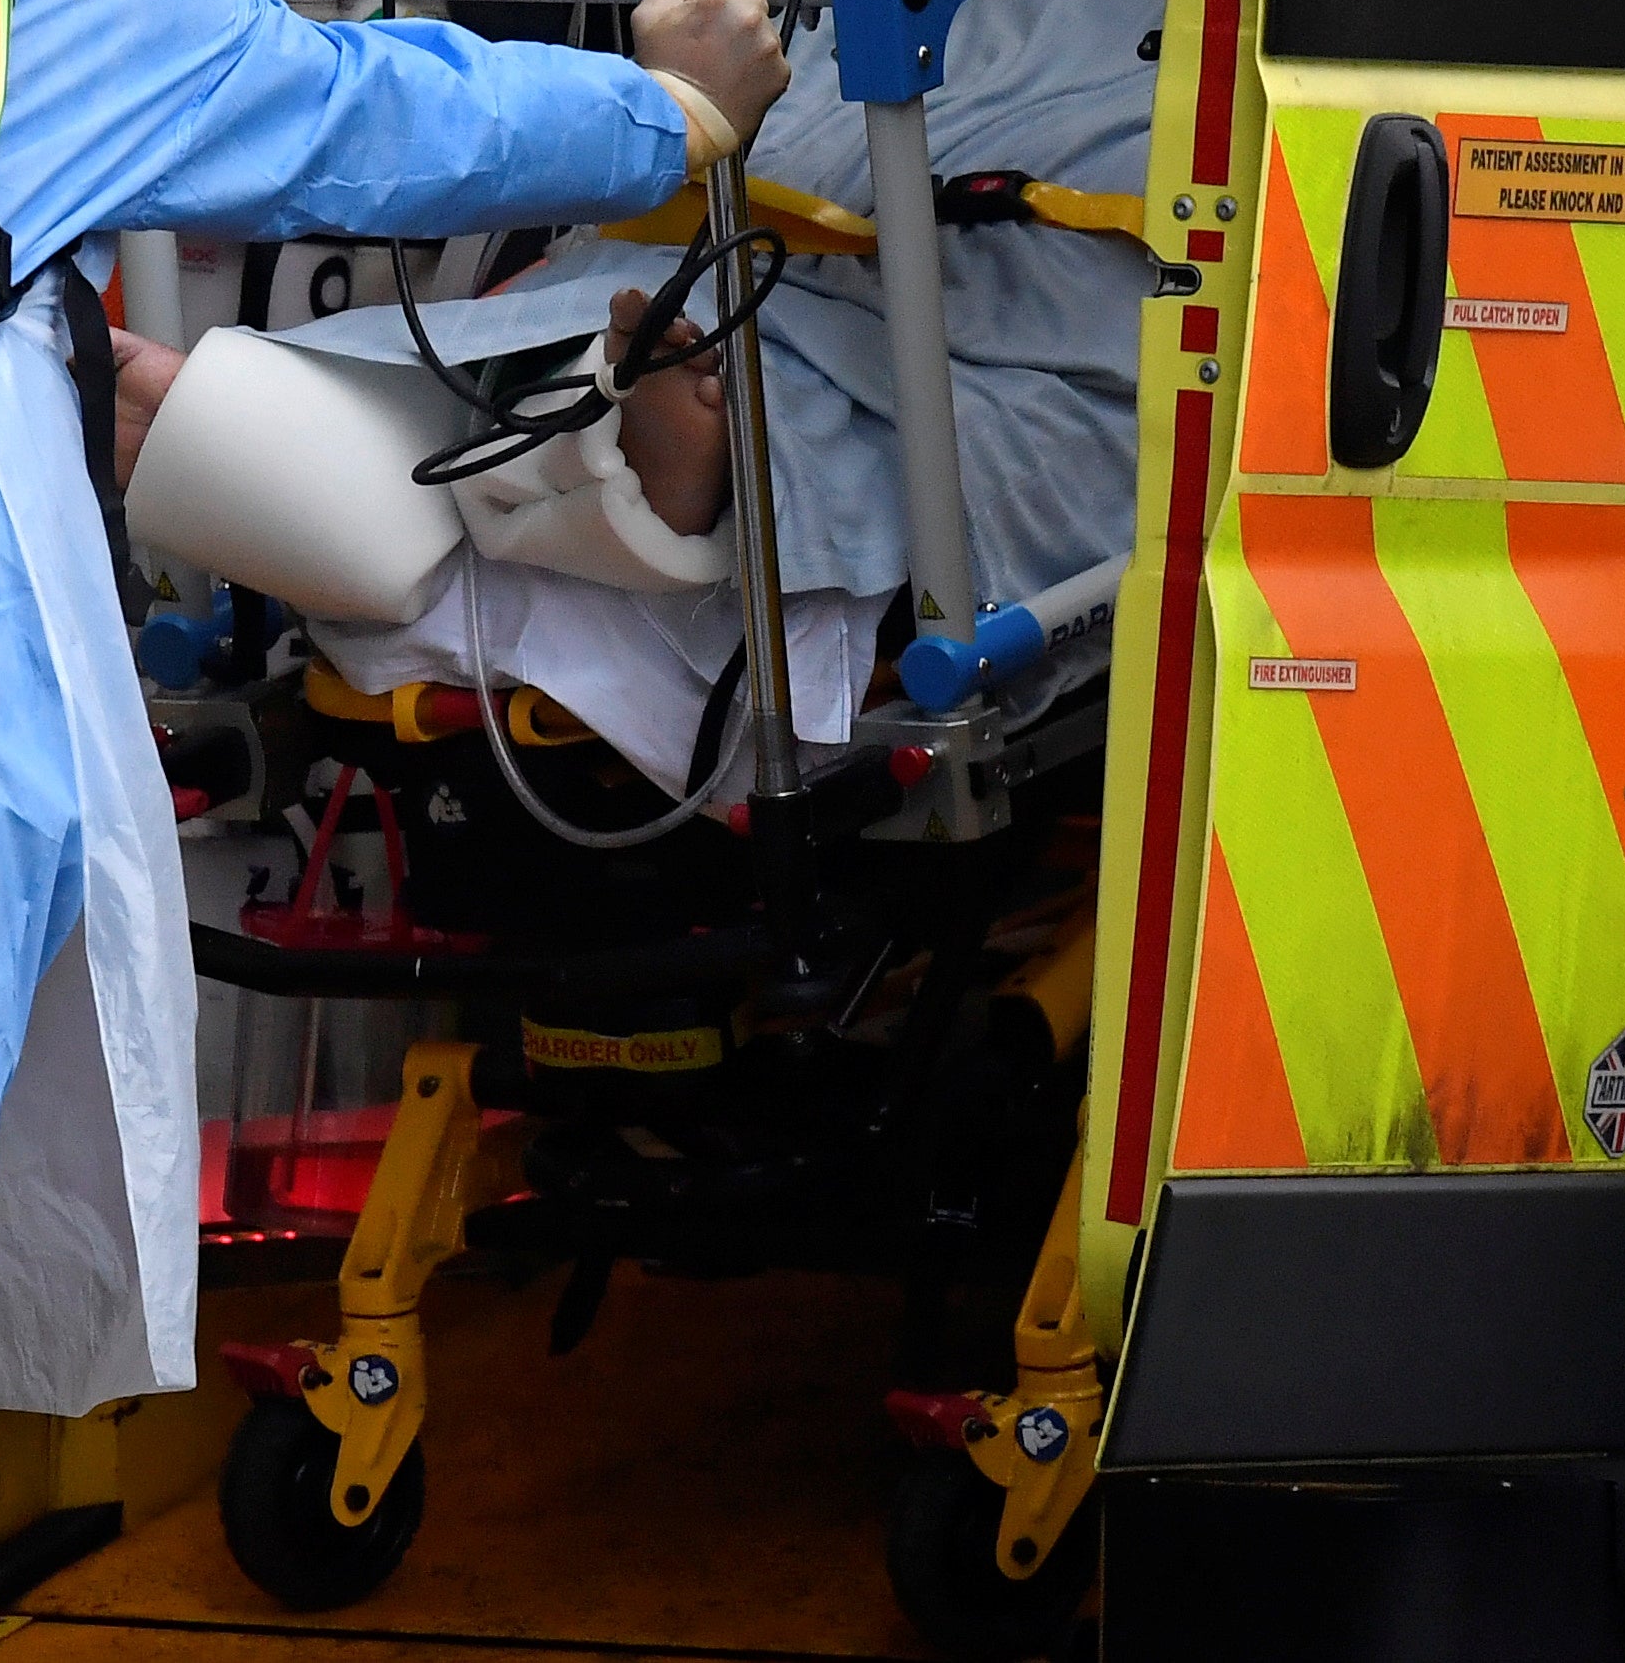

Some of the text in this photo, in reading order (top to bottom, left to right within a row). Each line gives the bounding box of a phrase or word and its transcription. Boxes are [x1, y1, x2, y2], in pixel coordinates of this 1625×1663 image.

[1470, 148, 1522, 171] PATIENT
[1525, 153, 1607, 176] ASSESSMENT
[1610, 156, 1624, 176] IN
[1499, 188, 1546, 211] PLEASE
[1549, 190, 1593, 213] KNOCK
[1597, 193, 1623, 214] AND
[1452, 304, 1560, 326] PULL CATCH TO OPEN
[1254, 664, 1352, 684] FIRE EXTINGUISHER
[629, 1038, 699, 1064] ONLY
